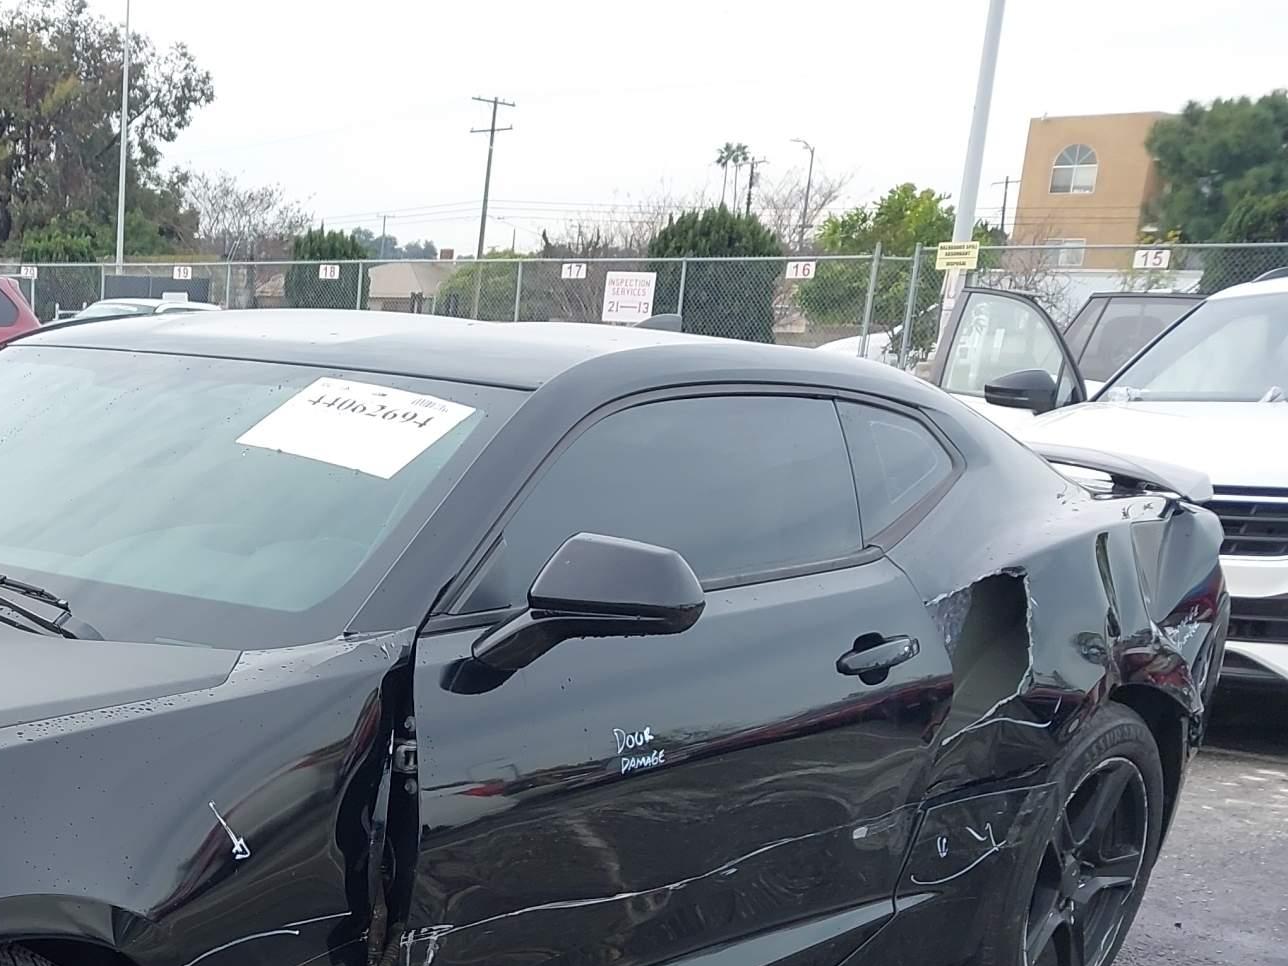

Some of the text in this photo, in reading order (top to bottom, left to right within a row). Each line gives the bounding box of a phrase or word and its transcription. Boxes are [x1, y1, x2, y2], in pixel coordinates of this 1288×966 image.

[1142, 251, 1163, 266] 15
[177, 267, 189, 278] 19
[323, 265, 336, 278] 18
[567, 264, 583, 277] 17
[792, 263, 811, 277] 16
[607, 279, 651, 287] INSPECTION
[612, 287, 647, 296] SERVICES
[306, 393, 435, 428] 44062694
[621, 749, 665, 774] DAMAGE
